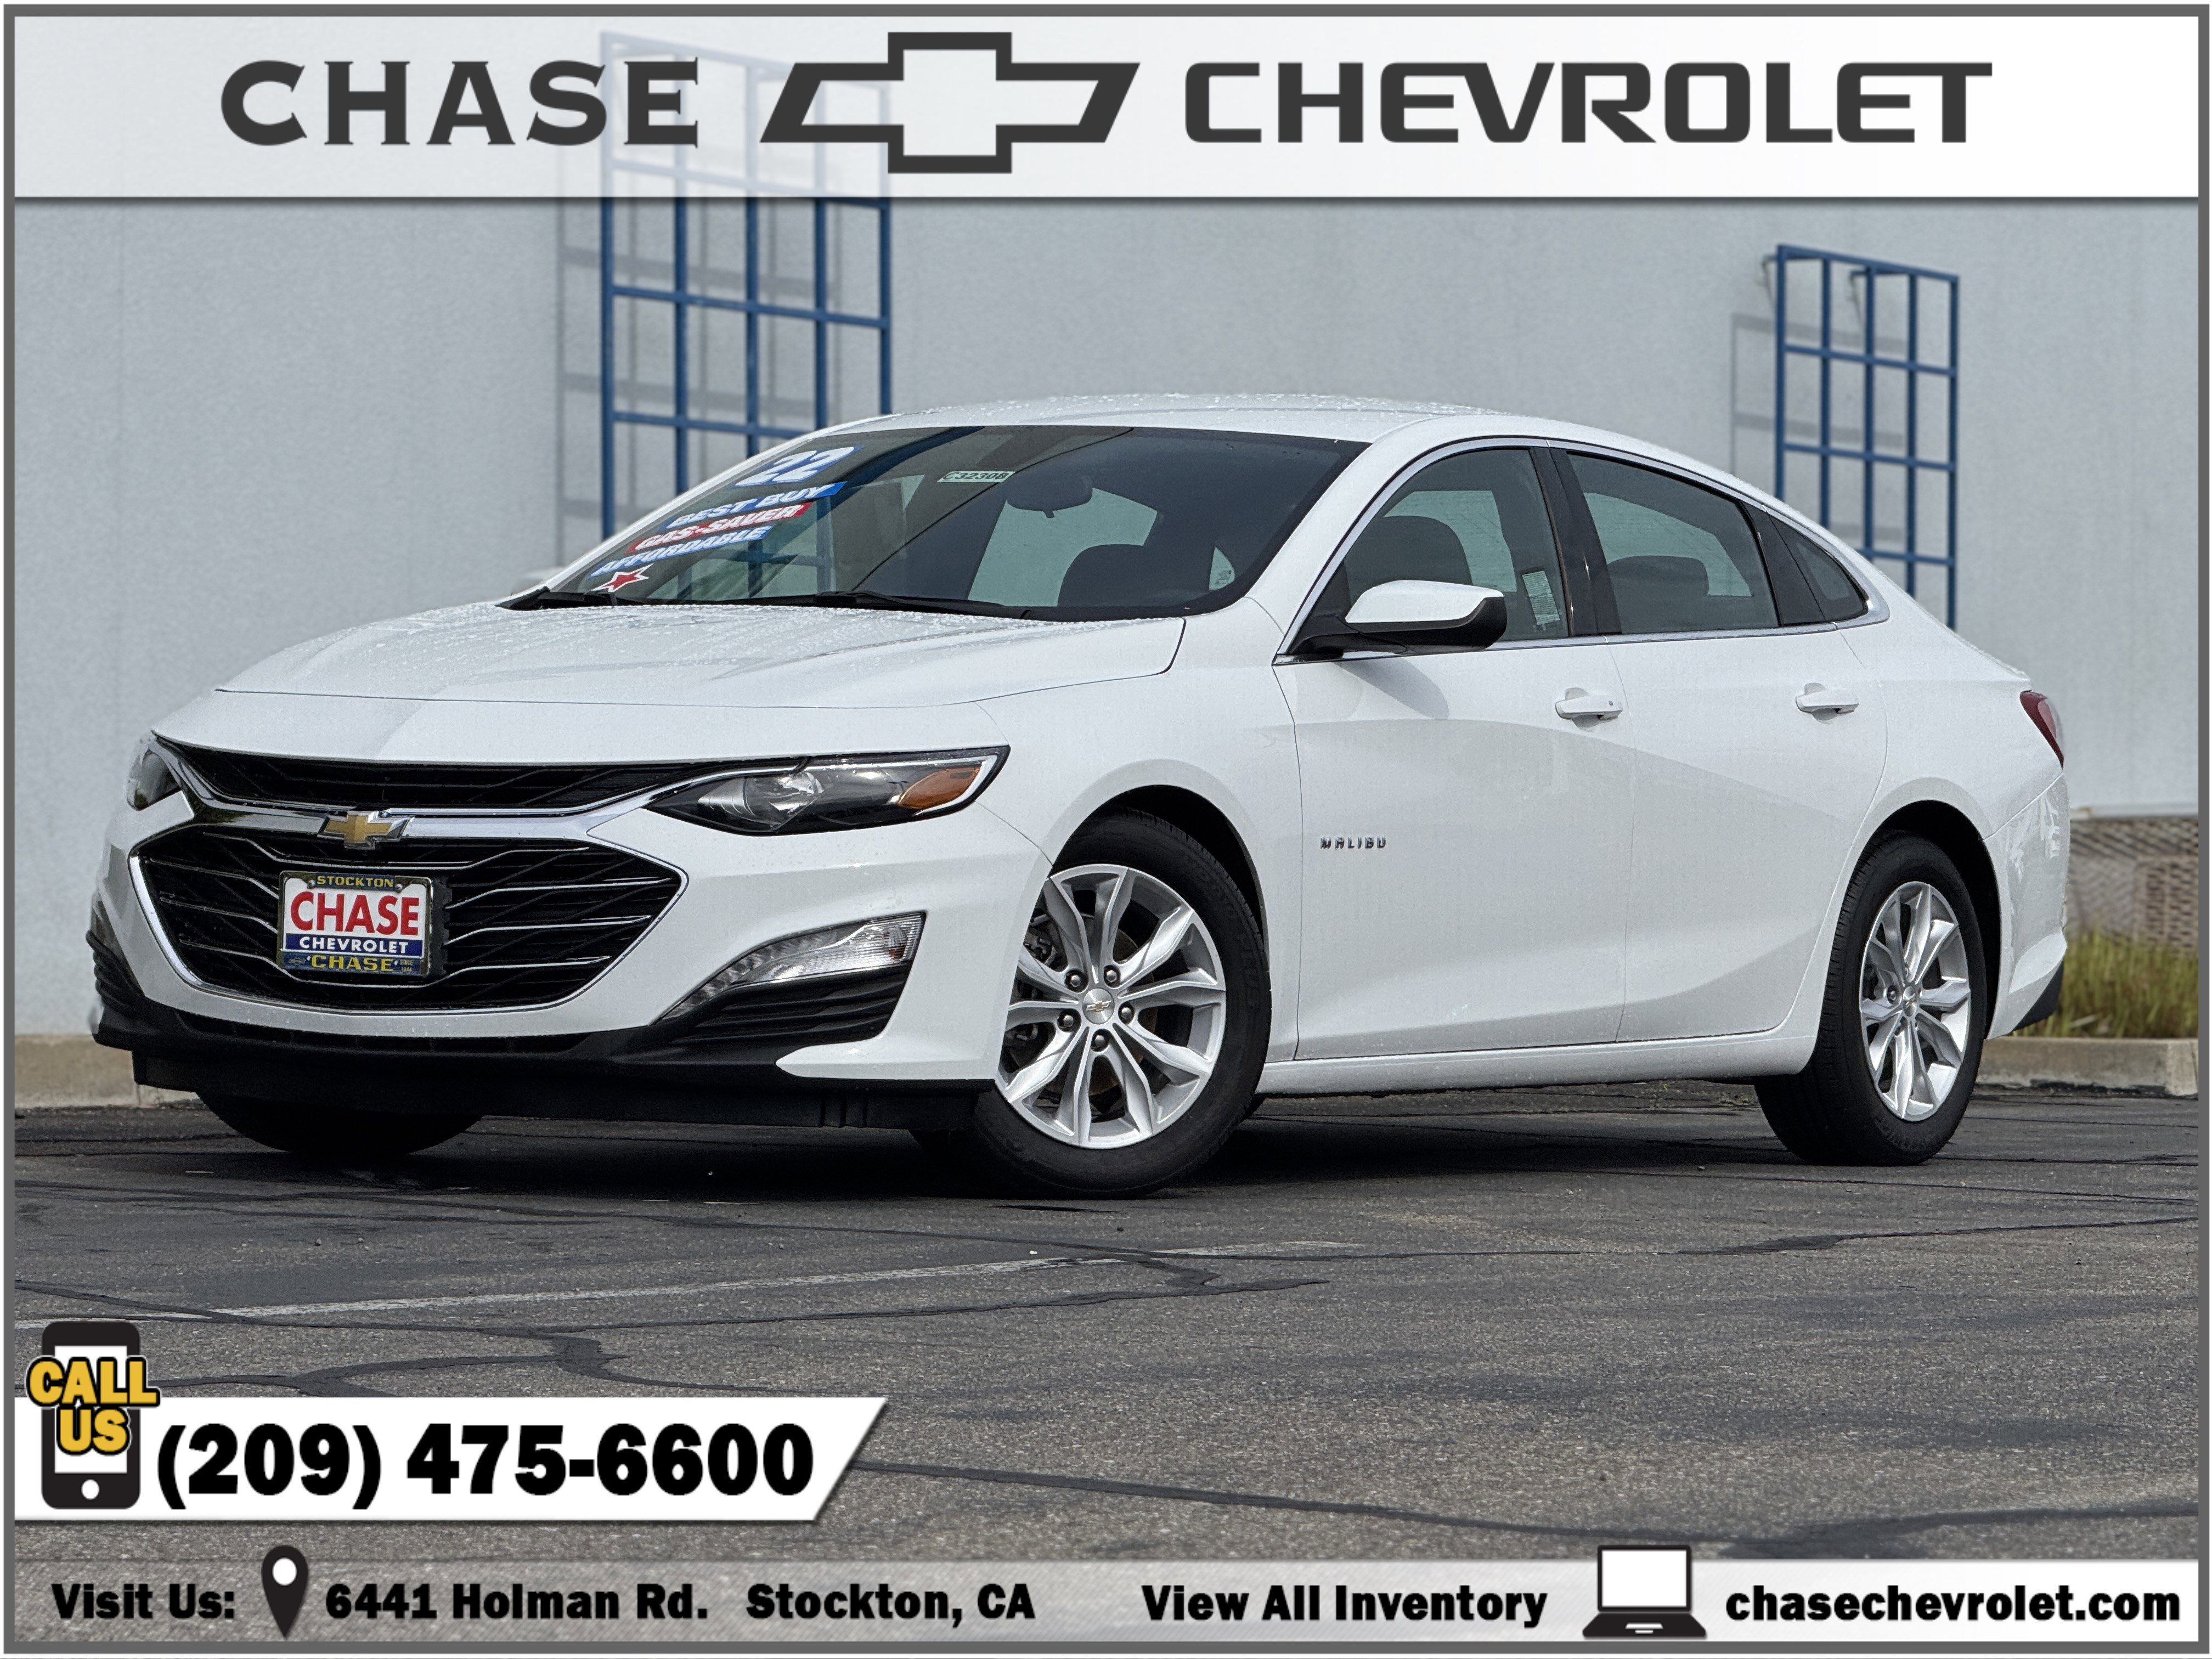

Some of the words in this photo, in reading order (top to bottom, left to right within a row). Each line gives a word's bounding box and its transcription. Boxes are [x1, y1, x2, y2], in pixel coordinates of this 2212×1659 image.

[736, 447, 855, 486] 22
[666, 498, 758, 528] BEST
[755, 484, 835, 508] BUY
[635, 505, 806, 550] GAS-SAVER
[591, 525, 774, 577] AFFORDABLE
[1320, 836, 1386, 849] MALIBU
[317, 875, 394, 889] STOCKTON
[290, 891, 420, 936] CHASE
[300, 936, 408, 954] CHEVROLET
[311, 955, 393, 972] CHASE
